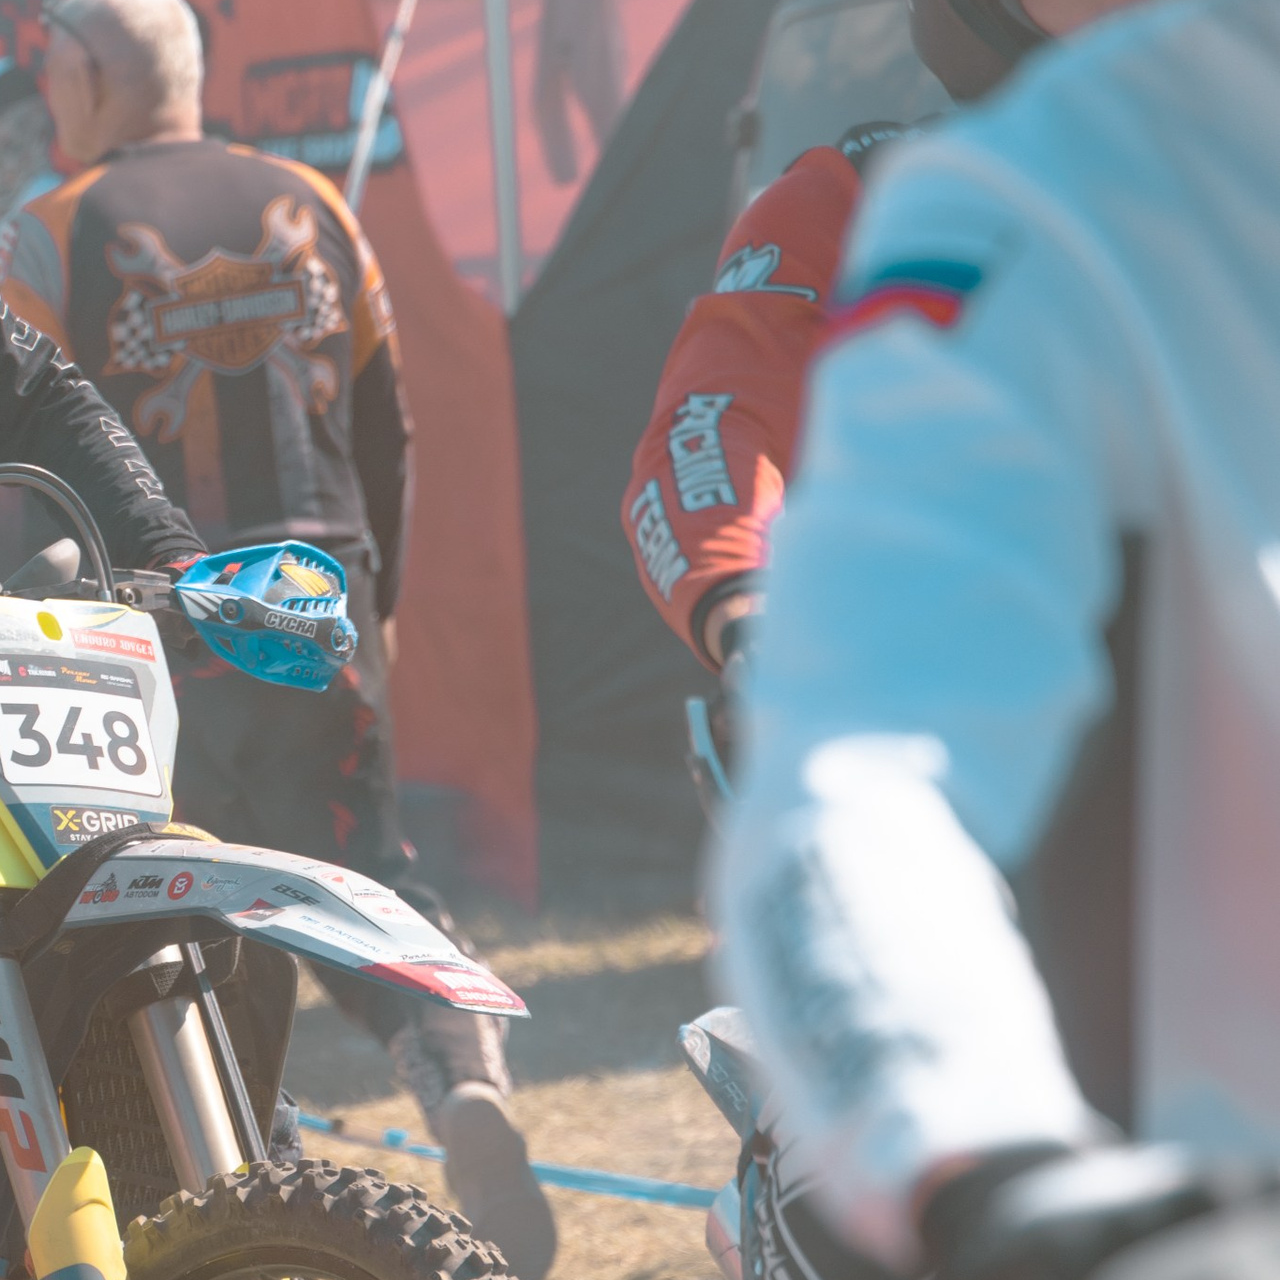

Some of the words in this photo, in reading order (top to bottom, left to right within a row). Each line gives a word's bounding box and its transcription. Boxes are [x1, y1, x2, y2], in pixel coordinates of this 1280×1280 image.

[669, 393, 737, 512] RACING
[630, 478, 689, 603] TEAM
[264, 611, 318, 639] CYCRA
[0, 703, 147, 777] 348
[127, 875, 164, 890] KTM
